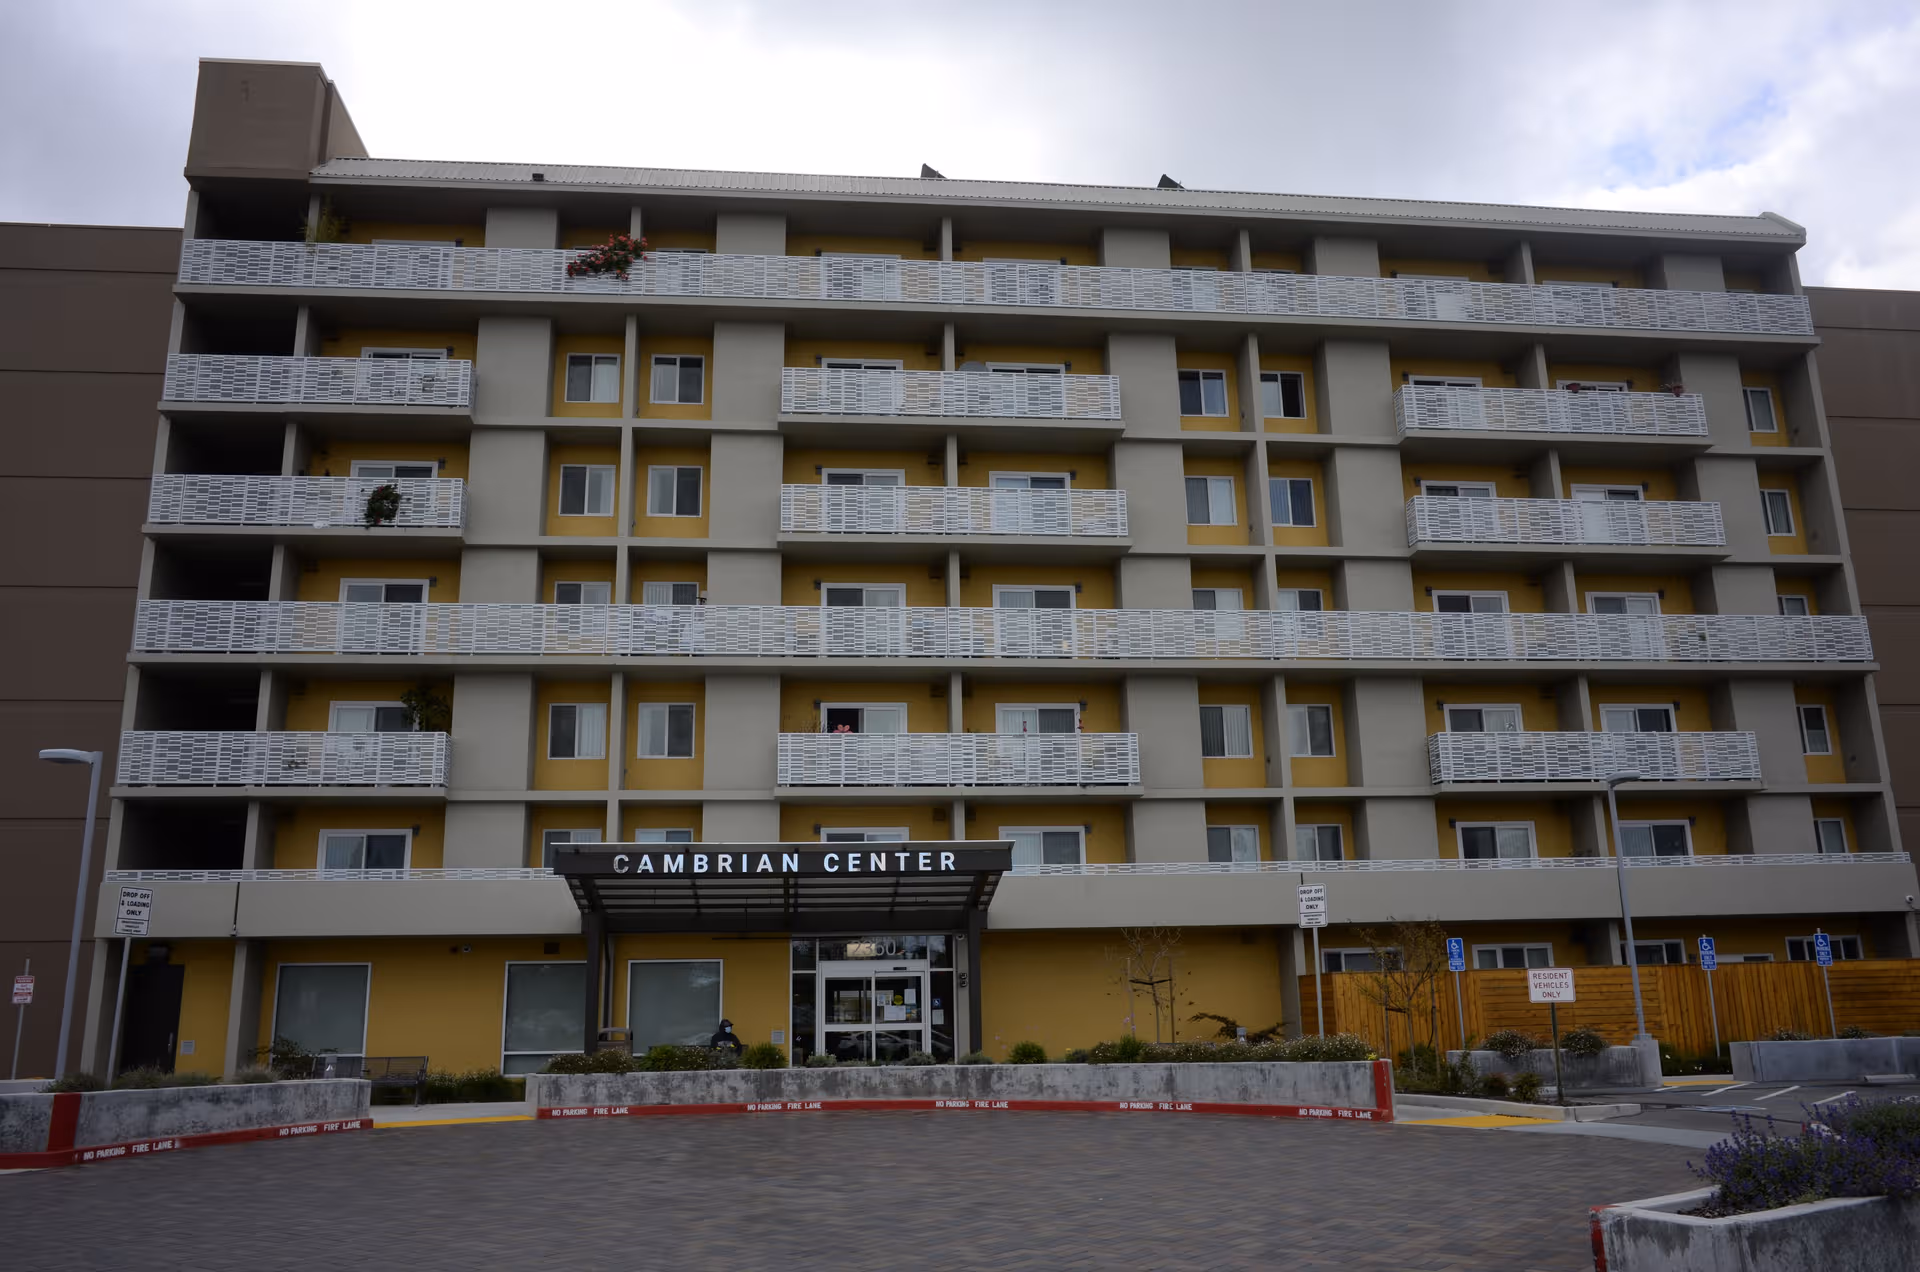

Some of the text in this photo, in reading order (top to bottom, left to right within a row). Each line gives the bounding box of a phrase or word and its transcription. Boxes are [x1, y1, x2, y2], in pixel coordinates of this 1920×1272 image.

[613, 852, 955, 873] CAMBRIAN CENTER
[127, 900, 150, 908] LOADING
[851, 940, 896, 955] 2360
[562, 1108, 588, 1116] PARKING
[593, 1107, 609, 1115] FIRE
[611, 1106, 629, 1114] LANE
[1309, 1108, 1333, 1116] PARKING
[1338, 1109, 1353, 1117] FIRE
[1355, 1110, 1373, 1119] LANE
[279, 1120, 361, 1136] NO PARKING FIRE LANE
[83, 1140, 173, 1160] NO PARKING FIRE LANE
